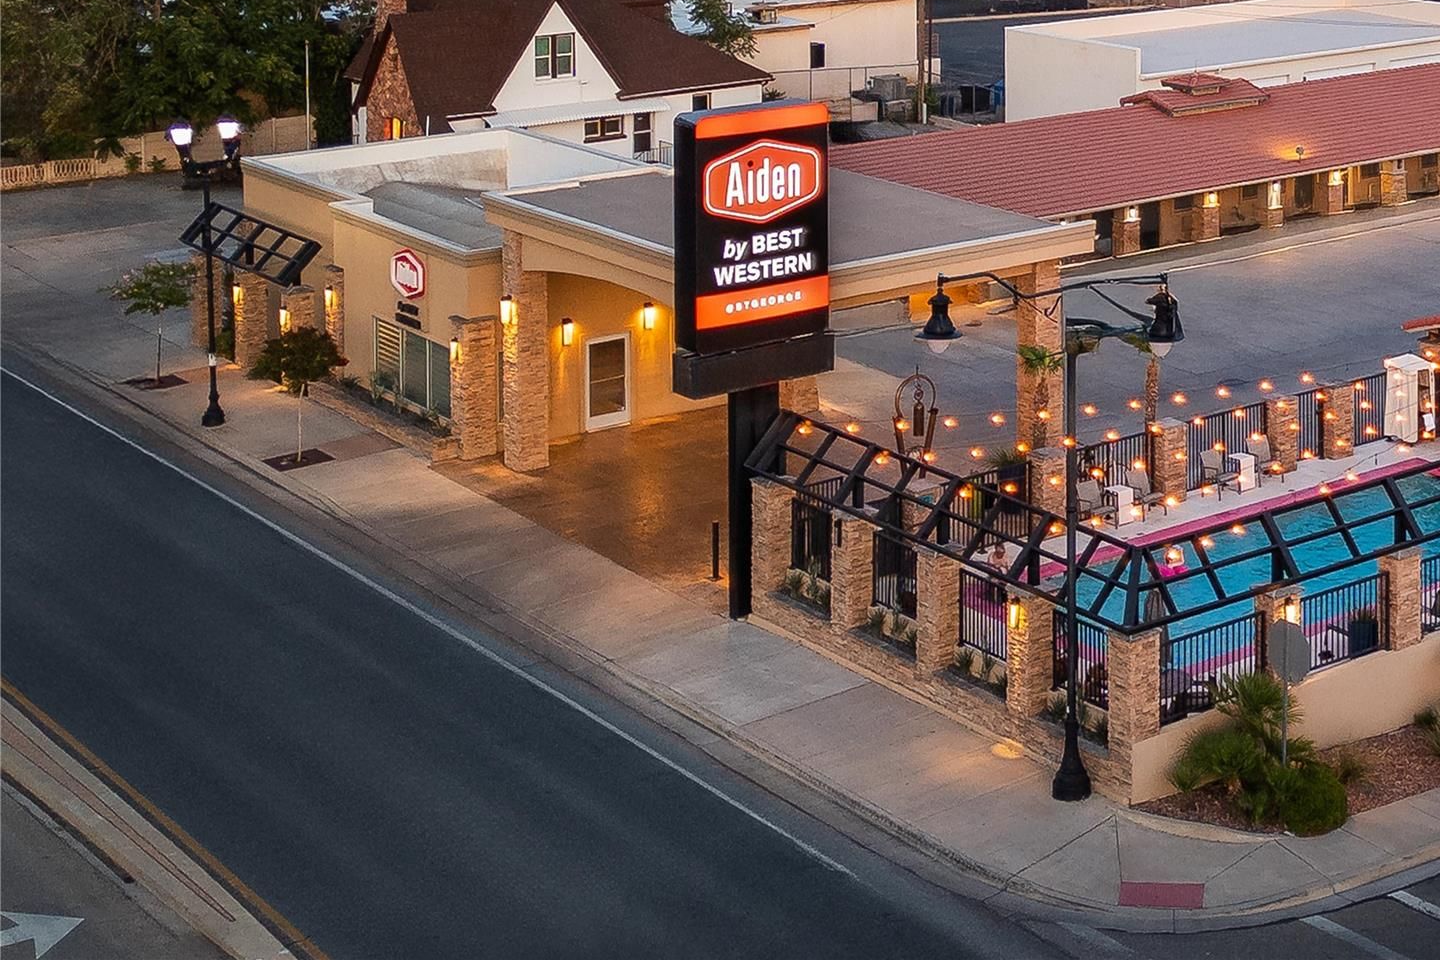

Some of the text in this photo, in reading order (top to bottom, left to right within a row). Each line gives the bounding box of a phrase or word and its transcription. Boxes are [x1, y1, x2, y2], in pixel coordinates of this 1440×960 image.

[726, 157, 801, 208] Aiden
[723, 227, 803, 261] by BEST
[713, 252, 812, 286] WESTERN
